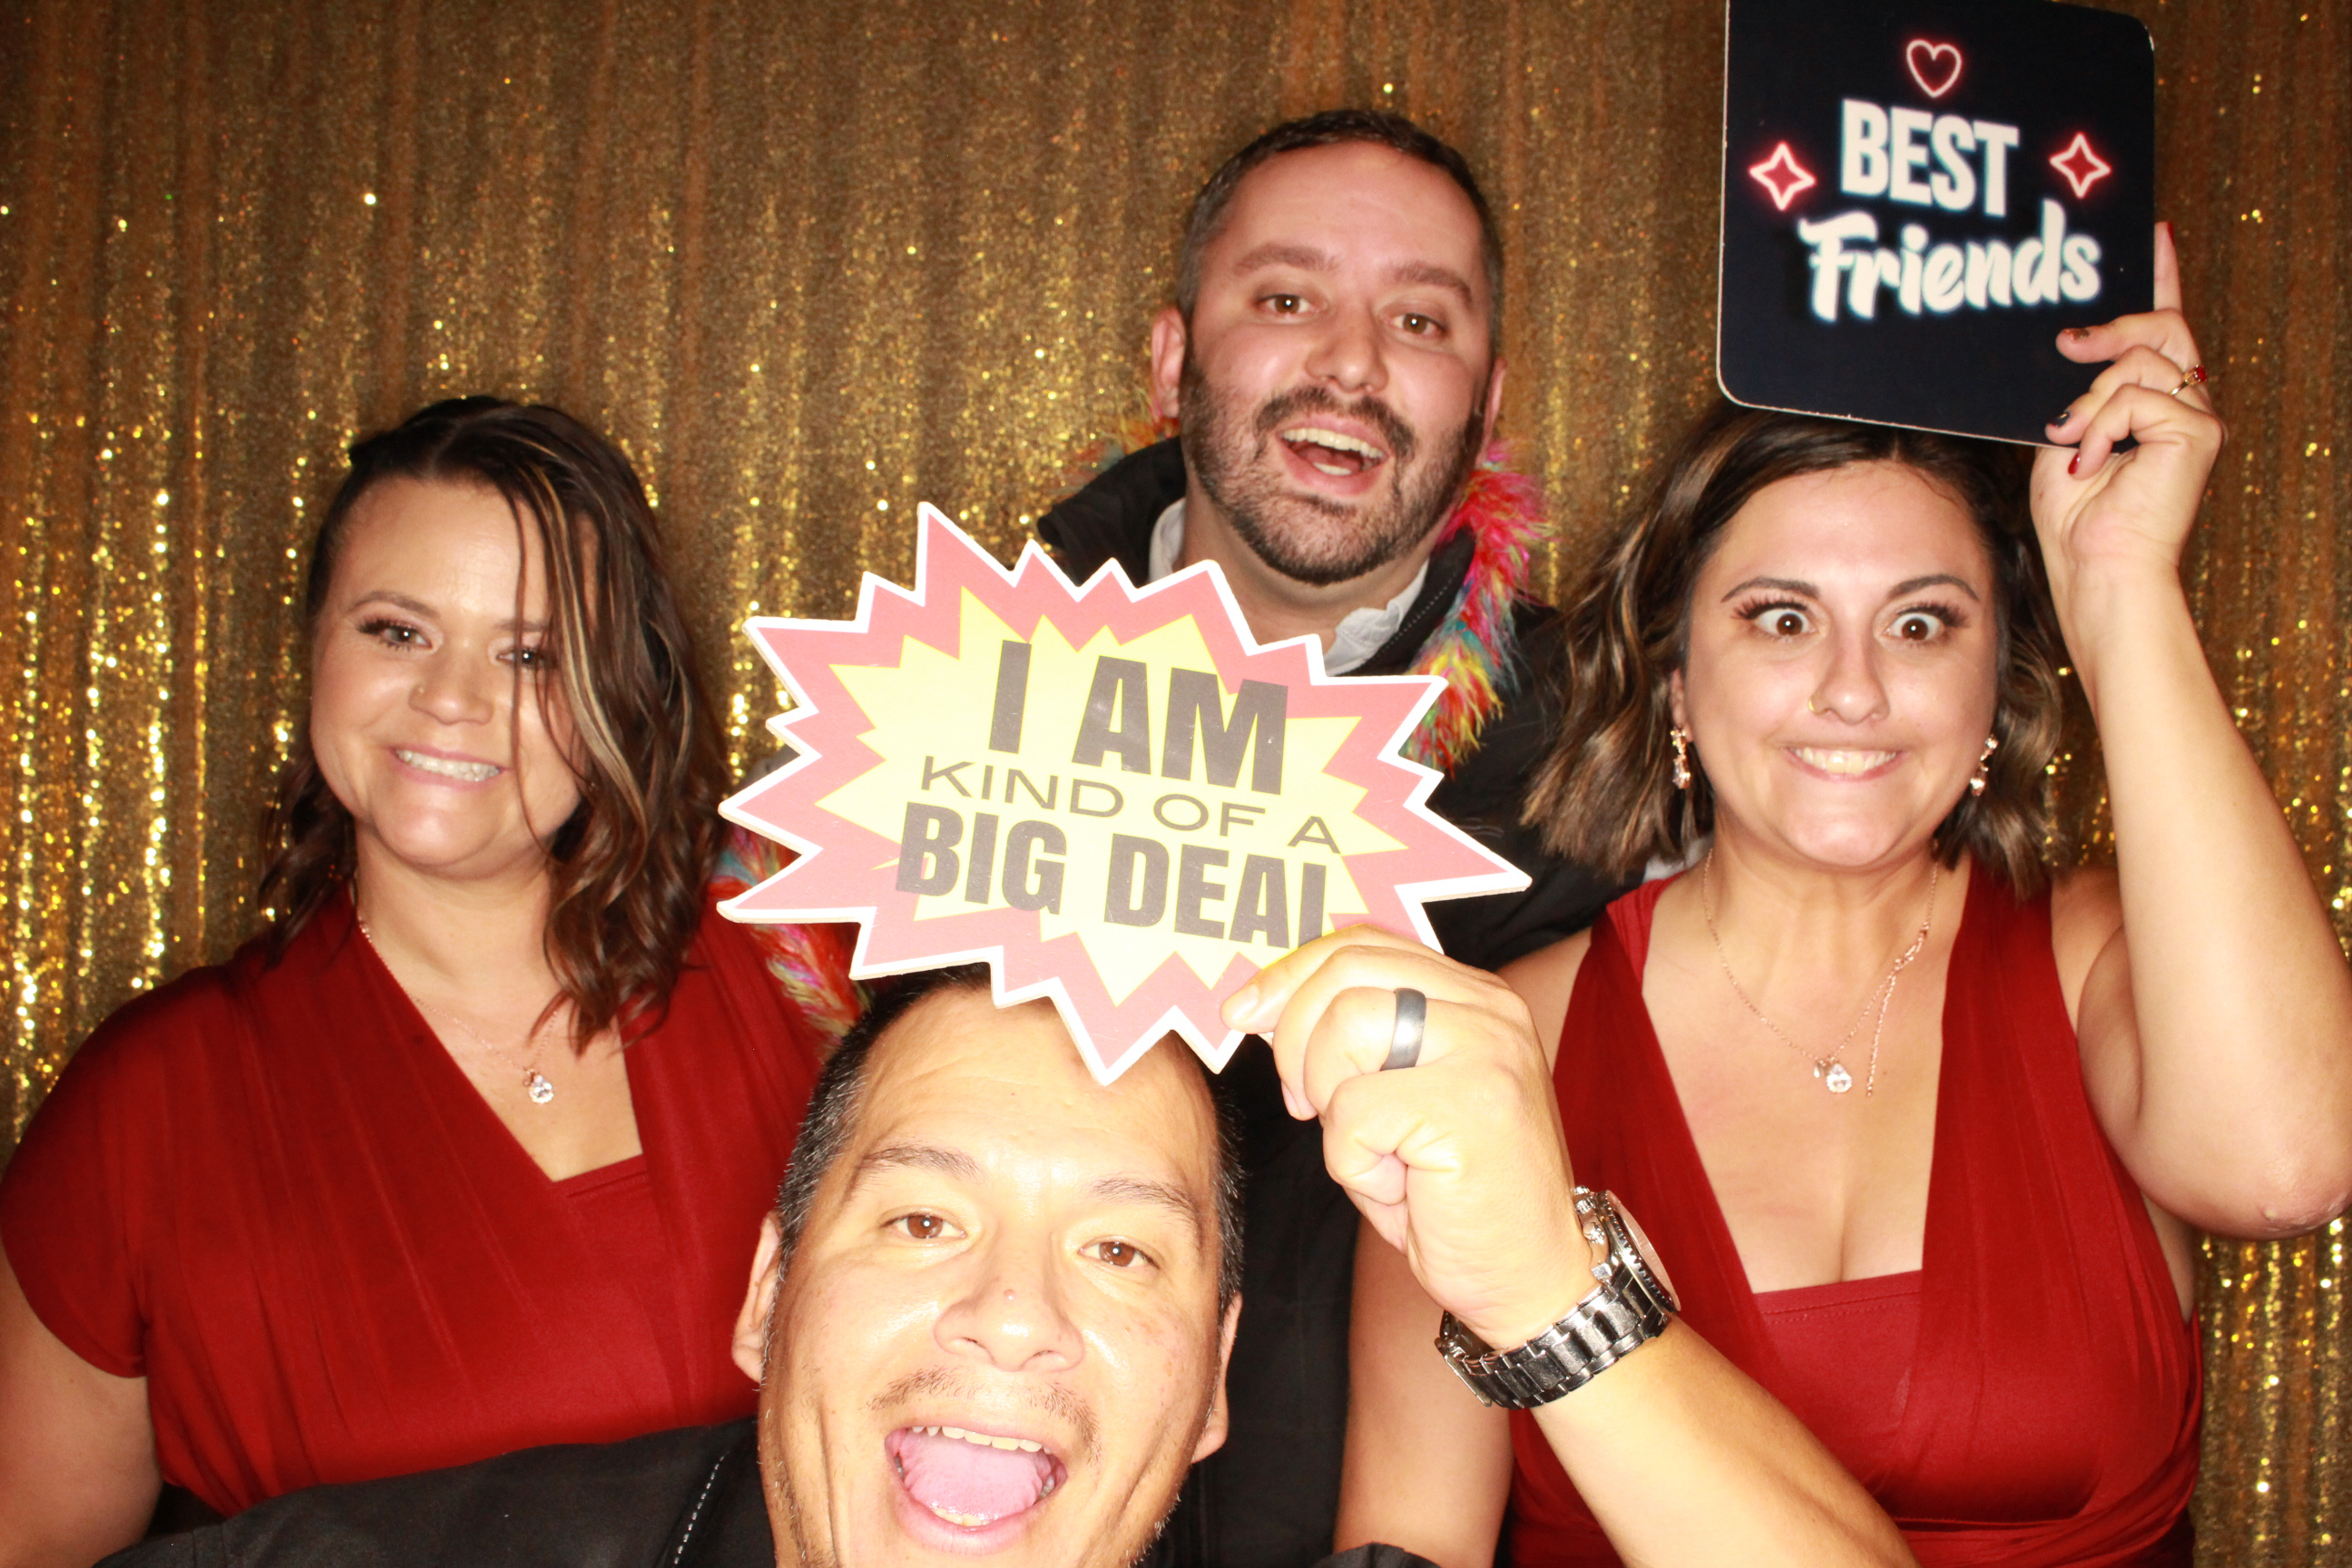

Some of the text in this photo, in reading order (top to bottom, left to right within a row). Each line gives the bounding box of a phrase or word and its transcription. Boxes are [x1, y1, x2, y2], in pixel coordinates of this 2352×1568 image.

[1841, 99, 2019, 217] BEST
[1798, 199, 2102, 322] Friends
[989, 640, 1289, 795] I AM
[896, 802, 1068, 914] BIG
[921, 756, 1341, 854] KIND OF A
